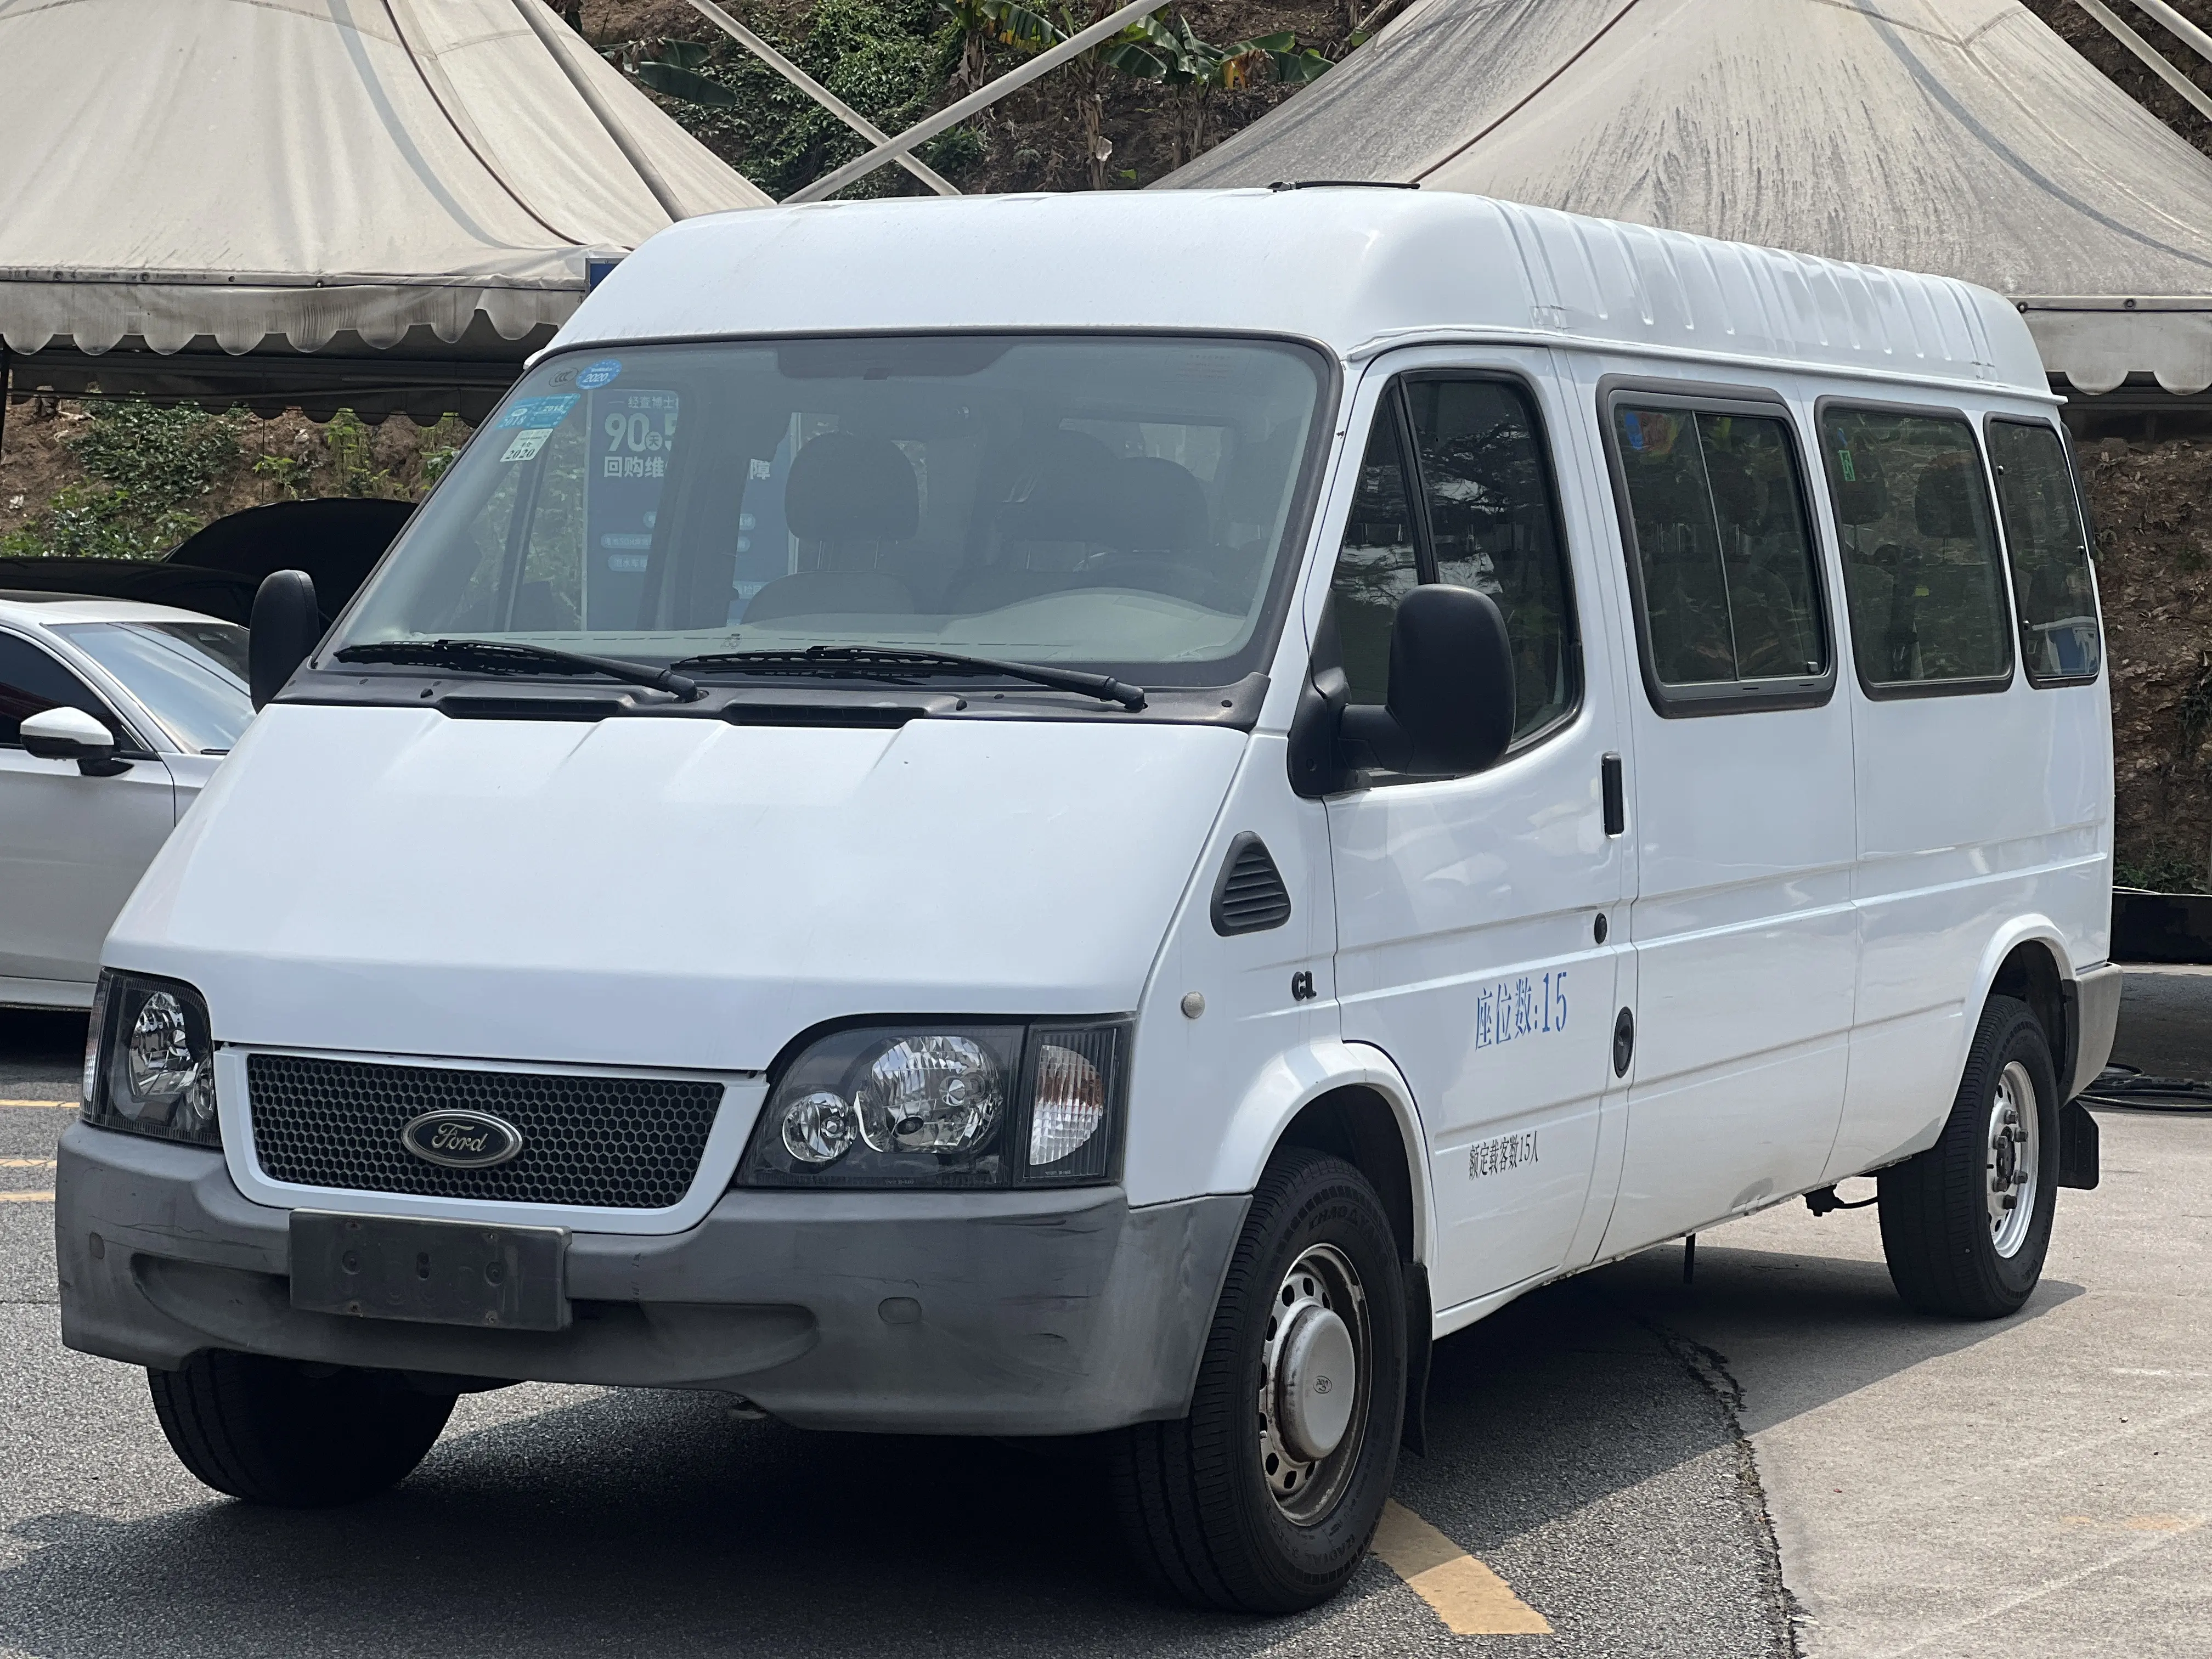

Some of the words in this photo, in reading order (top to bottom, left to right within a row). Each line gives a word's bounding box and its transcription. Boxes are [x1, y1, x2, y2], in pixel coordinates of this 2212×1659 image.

[582, 373, 609, 383] 2020
[628, 396, 679, 409] 经查博士
[504, 448, 535, 459] 2020
[604, 456, 668, 478] 回购维
[431, 1122, 488, 1152] Ford
[1469, 1130, 1538, 1181] 额定载客数15人
